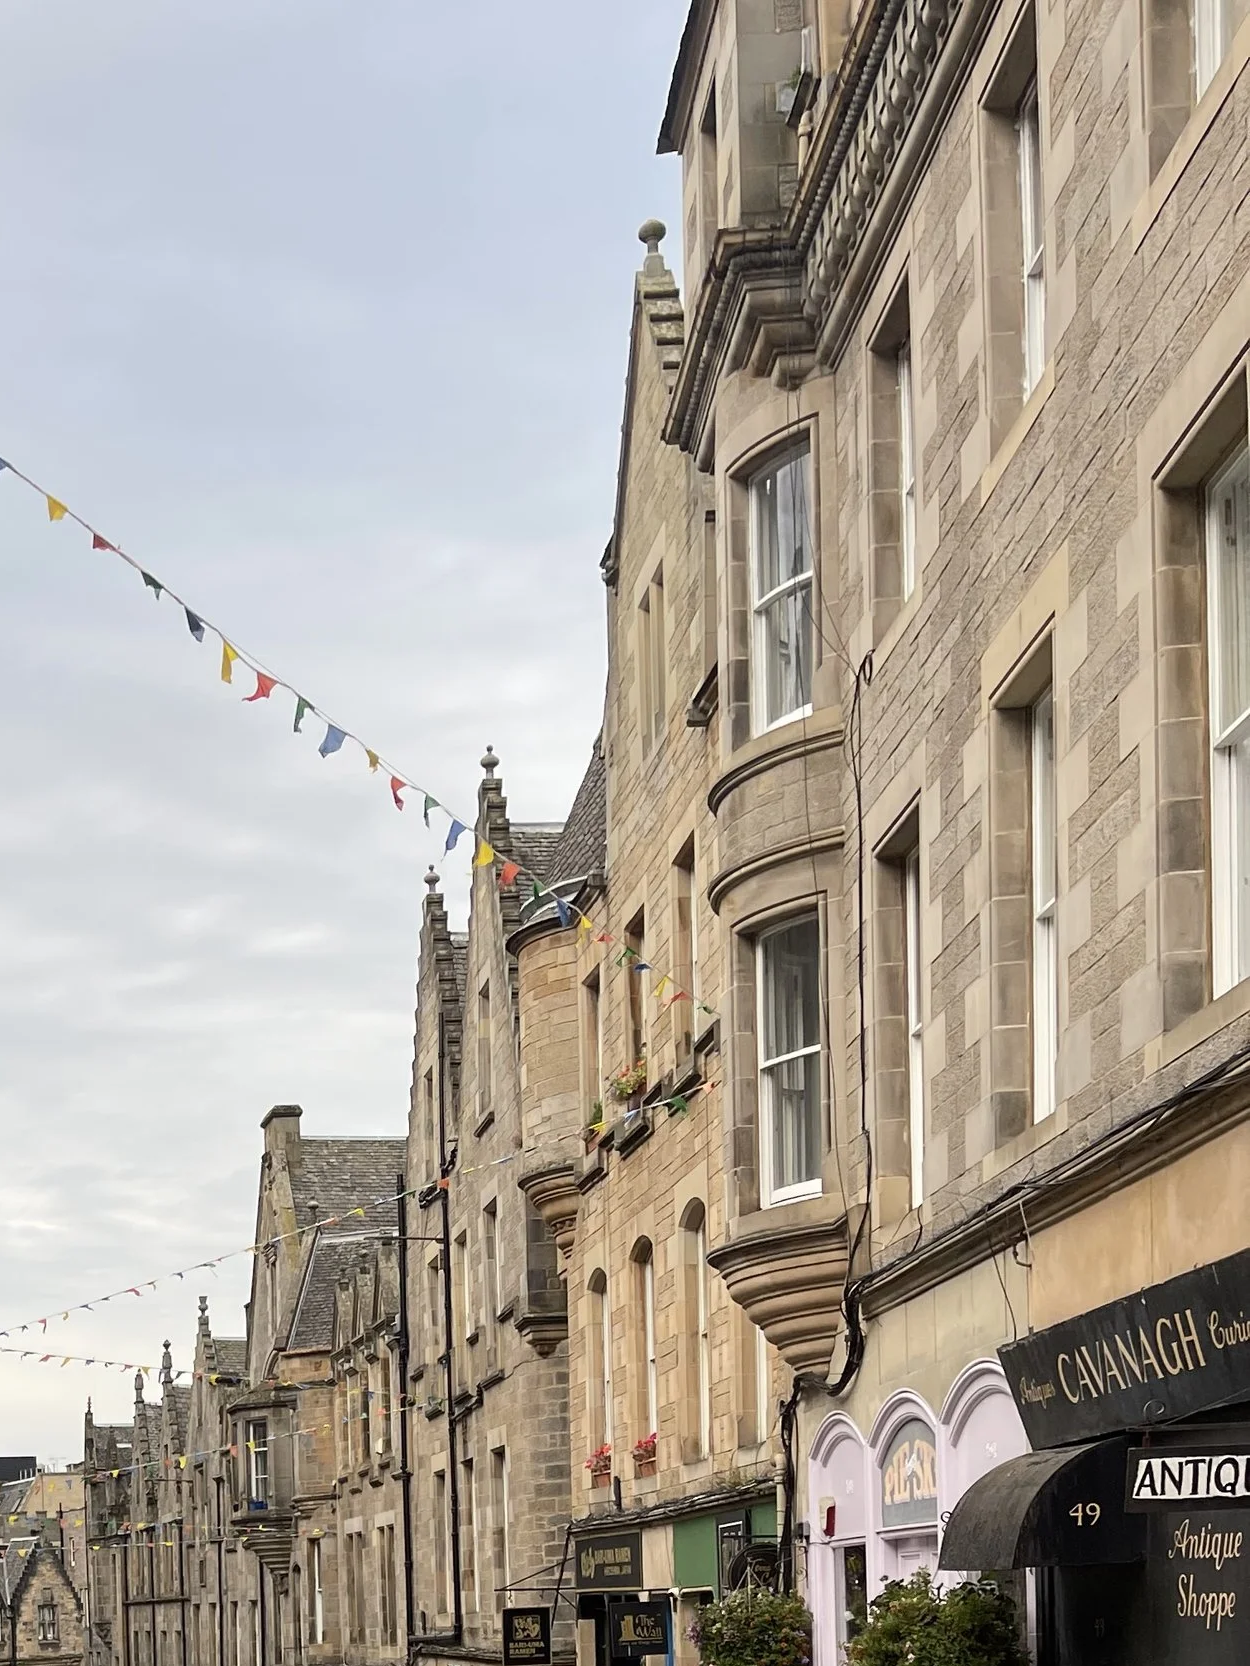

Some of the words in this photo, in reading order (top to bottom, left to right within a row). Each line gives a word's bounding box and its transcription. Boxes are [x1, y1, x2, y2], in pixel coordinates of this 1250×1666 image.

[1019, 1377, 1056, 1409] Antiques
[1057, 1309, 1206, 1404] CAVANAGH
[1135, 1457, 1250, 1497] ANTIQ
[1068, 1502, 1101, 1526] 49
[1168, 1518, 1243, 1570] Antique
[635, 1614, 655, 1627] The
[1177, 1573, 1236, 1631] Shoppe
[636, 1626, 662, 1638] Wall
